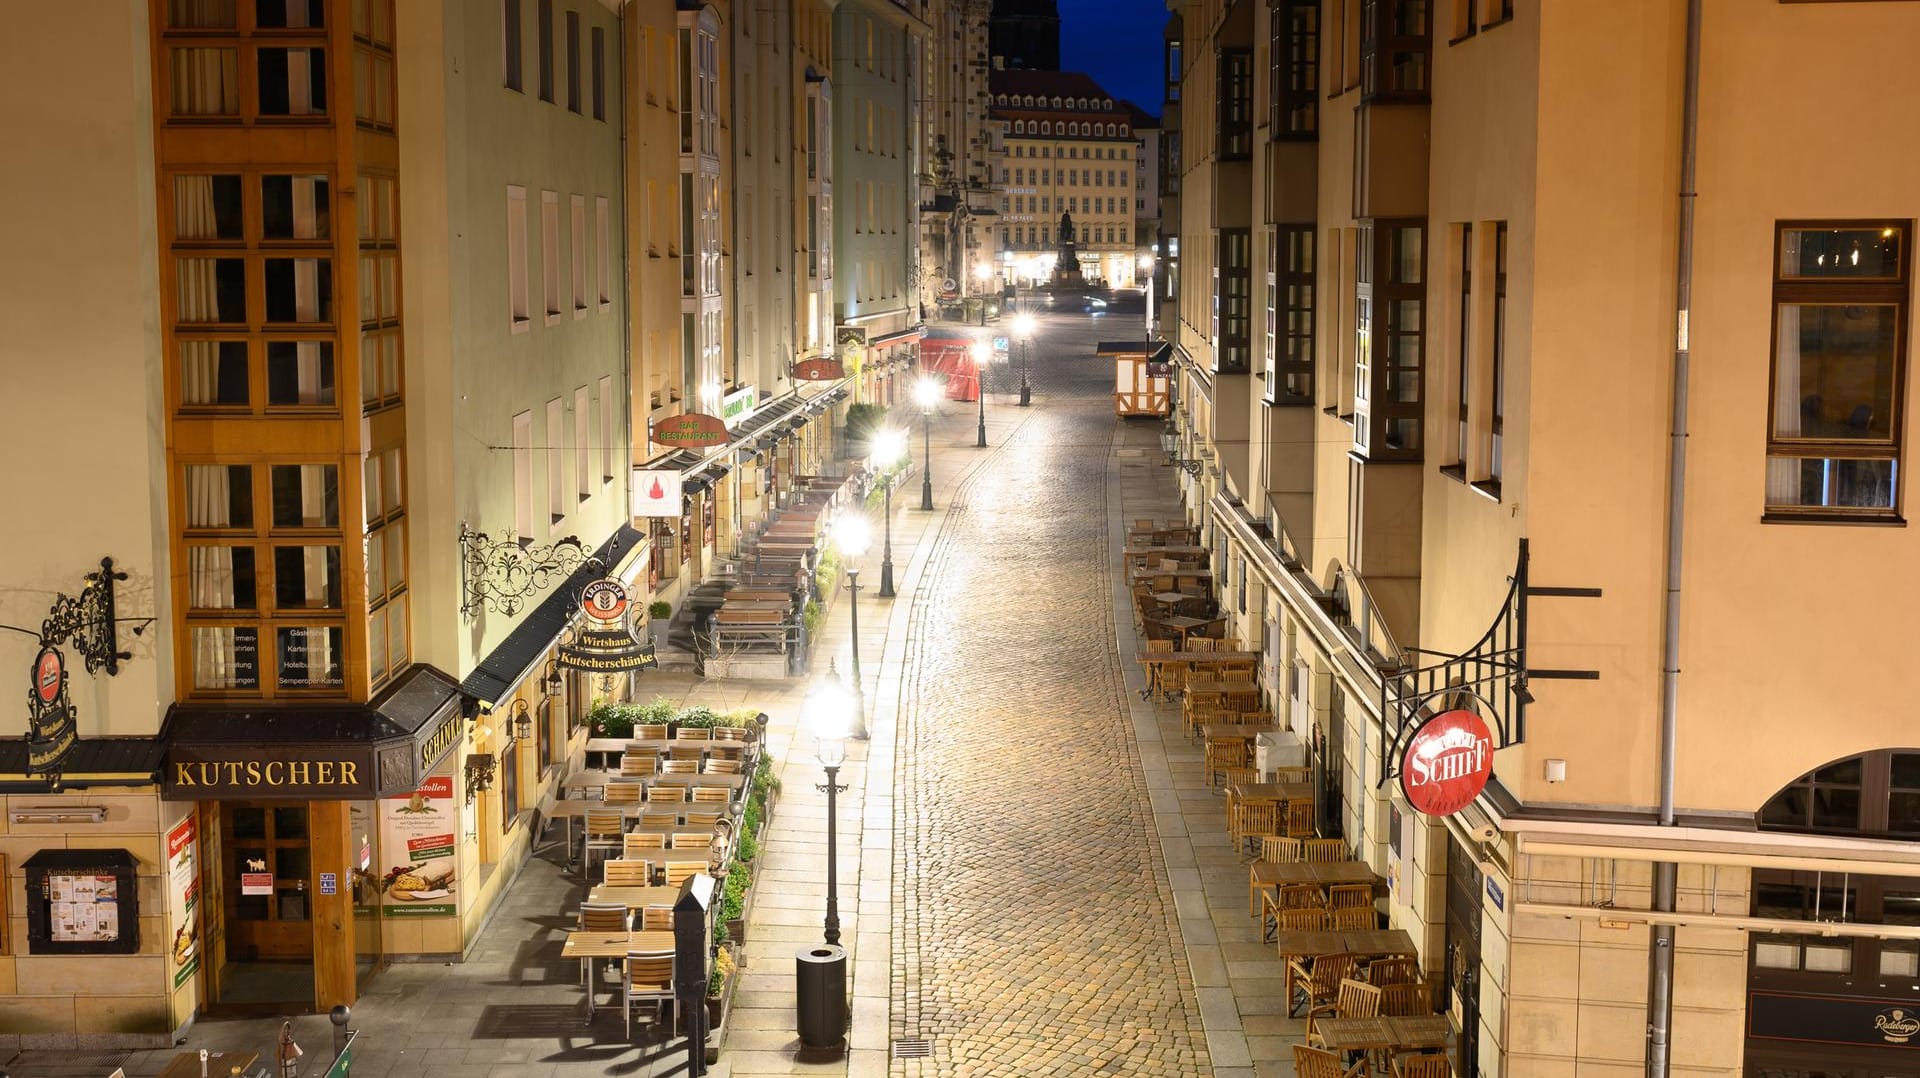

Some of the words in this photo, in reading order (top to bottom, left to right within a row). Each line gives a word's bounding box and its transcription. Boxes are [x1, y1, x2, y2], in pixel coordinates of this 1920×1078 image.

[680, 421, 698, 430] BAR
[660, 431, 720, 440] RESTAURANT
[585, 583, 624, 599] ERDINGER
[583, 635, 631, 648] Wirtshaus
[561, 652, 653, 669] Kutscherschänke
[1411, 737, 1489, 787] SCHIFF
[175, 761, 360, 786] KUTSCHER
